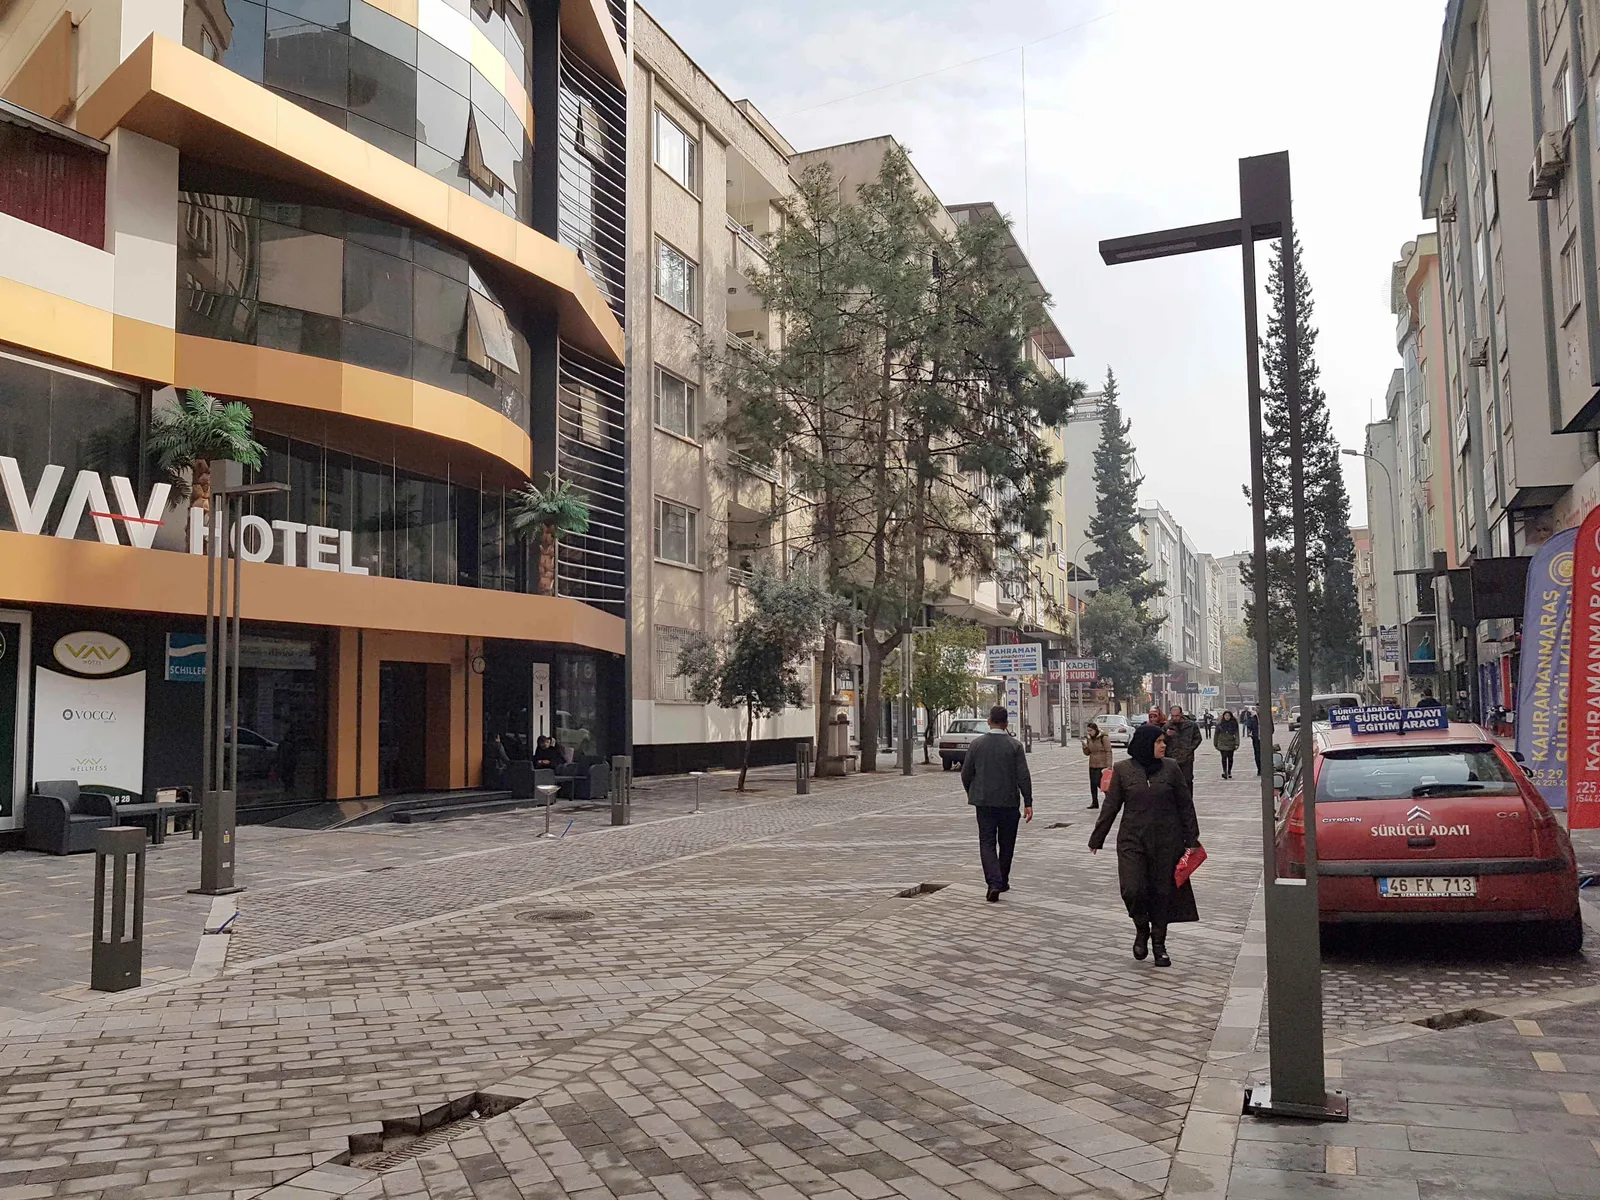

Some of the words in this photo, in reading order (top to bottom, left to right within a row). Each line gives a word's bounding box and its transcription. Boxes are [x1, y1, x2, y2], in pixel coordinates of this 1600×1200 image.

[0, 455, 172, 550] VAV
[190, 506, 370, 576] HOTEL
[64, 643, 121, 660] VAV
[988, 646, 1037, 655] KAHRAMAN
[169, 665, 207, 675] SCHILLER
[1065, 660, 1095, 670] KADEMİ
[1070, 671, 1096, 680] KURSU
[1532, 590, 1560, 762] KAHRAMANMARAŞ
[75, 710, 117, 721] VOCCA
[1354, 710, 1402, 723] SÜRÜCÜ
[1407, 708, 1442, 720] ADAYI
[1402, 719, 1440, 729] ARACI
[1548, 769, 1564, 779] 29
[1371, 823, 1425, 837] SÜRÜCÜ
[1429, 825, 1470, 836] ADAYI
[1390, 878, 1408, 892] 46
[1415, 878, 1435, 892] FK
[1442, 878, 1472, 892] 713
